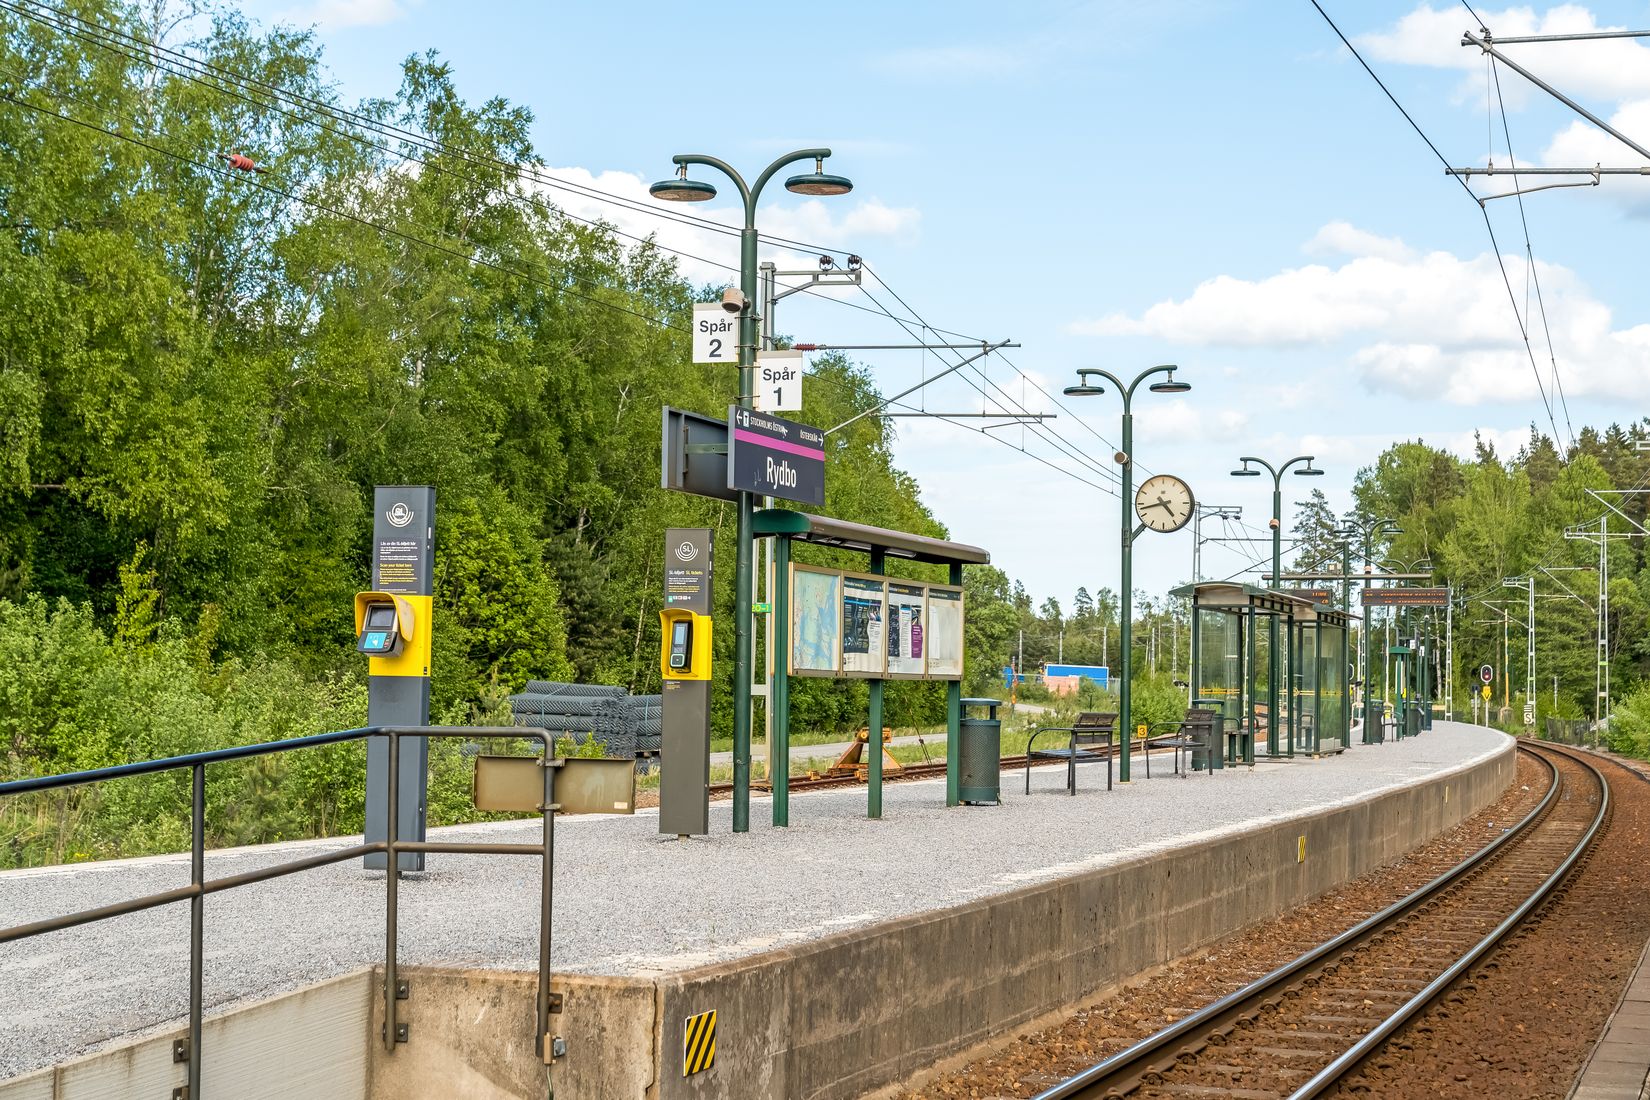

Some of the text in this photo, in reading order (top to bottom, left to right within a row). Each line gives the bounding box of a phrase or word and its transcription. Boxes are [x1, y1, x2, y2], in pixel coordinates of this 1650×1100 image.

[699, 318, 733, 335] Spår
[708, 338, 722, 358] 2
[762, 366, 796, 384] Spår
[773, 387, 783, 406] 1
[750, 416, 773, 431] STOCKHOLMS
[766, 456, 797, 490] Rydbo
[1525, 713, 1532, 723] S
[1139, 727, 1146, 736] 3
